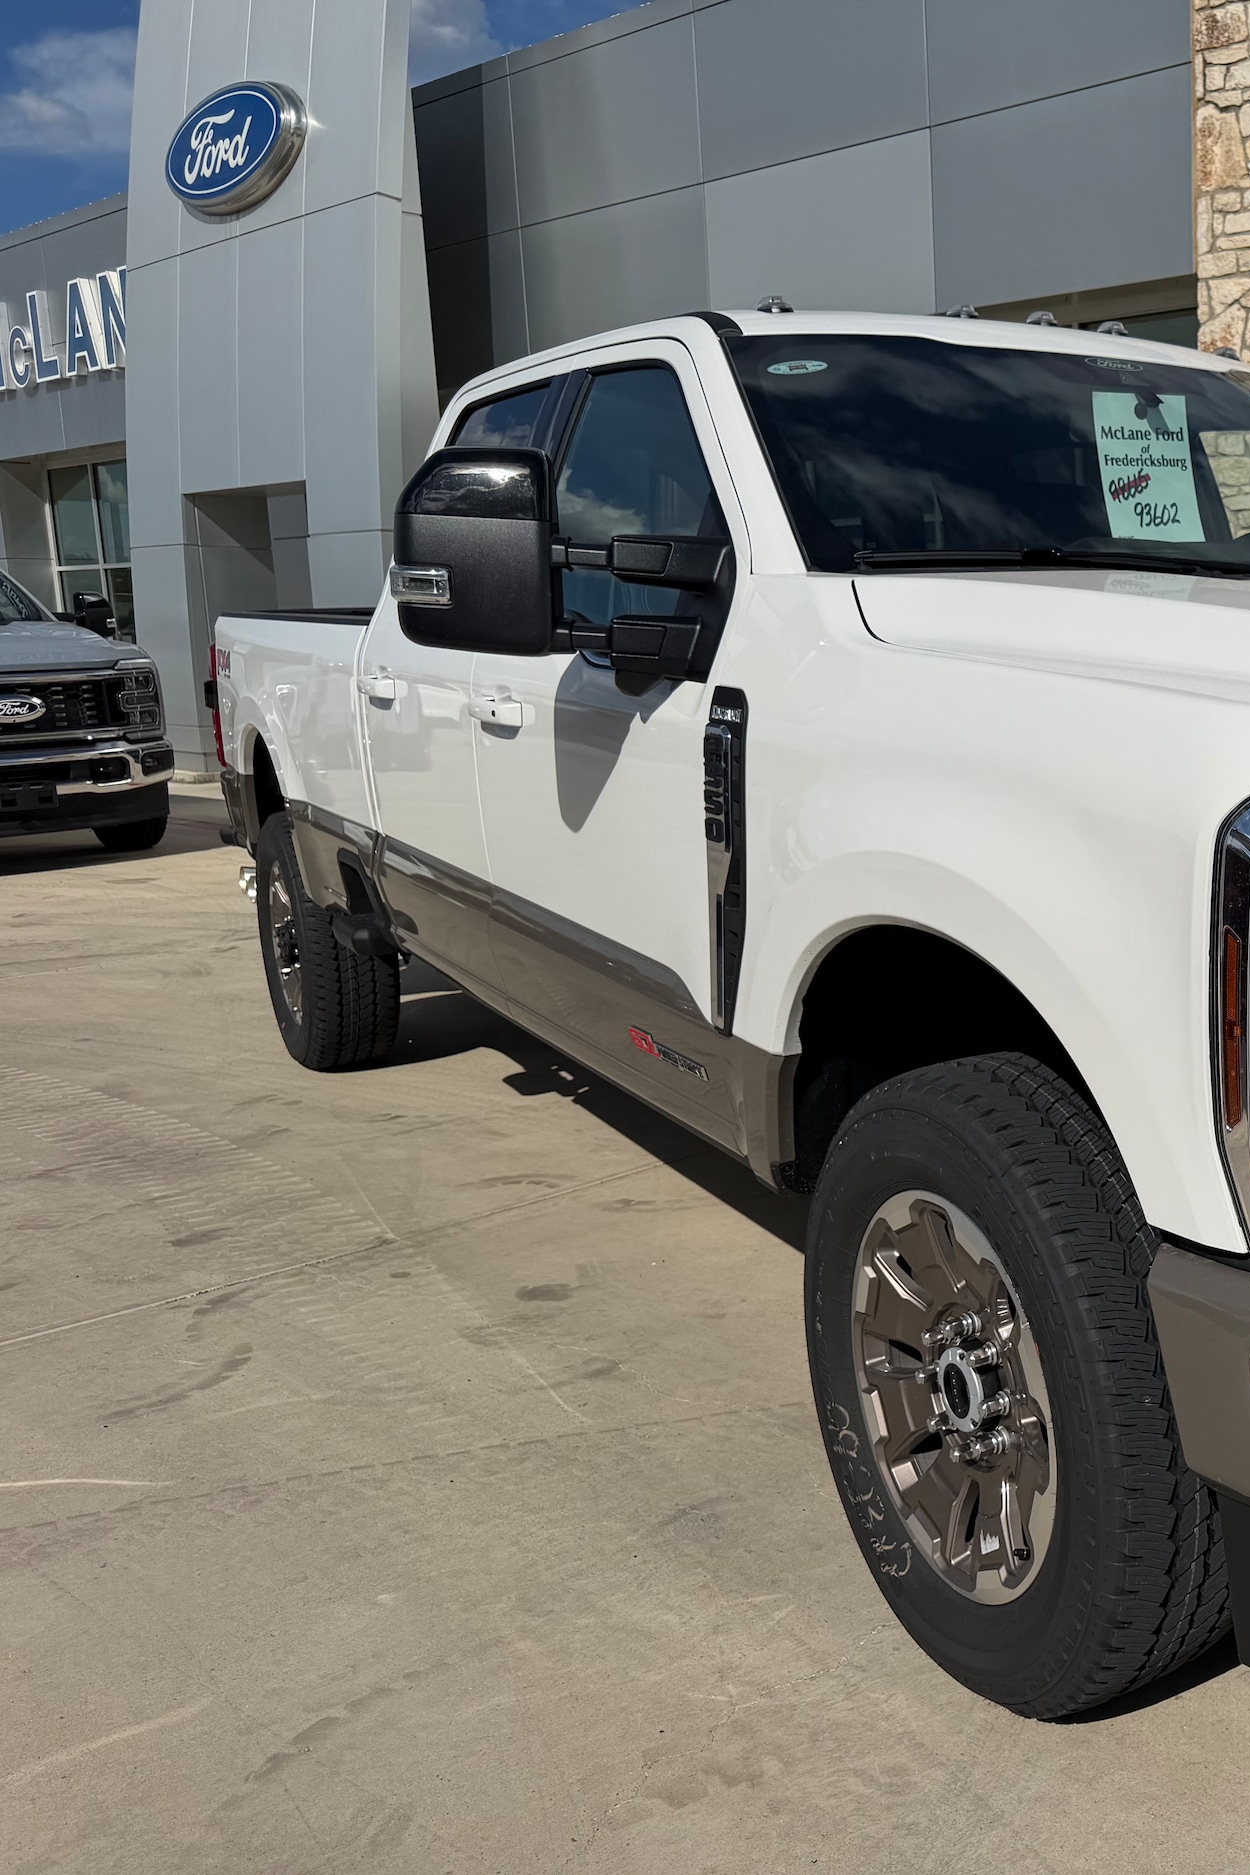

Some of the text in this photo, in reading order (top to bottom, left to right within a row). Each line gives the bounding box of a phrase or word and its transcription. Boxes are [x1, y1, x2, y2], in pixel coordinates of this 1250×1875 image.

[184, 108, 253, 185] Ford
[1101, 426, 1184, 442] McLane Ford
[1140, 444, 1151, 454] of
[1104, 454, 1188, 471] Fredericksburg
[1134, 502, 1181, 528] 93602
[0, 702, 30, 715] Ford
